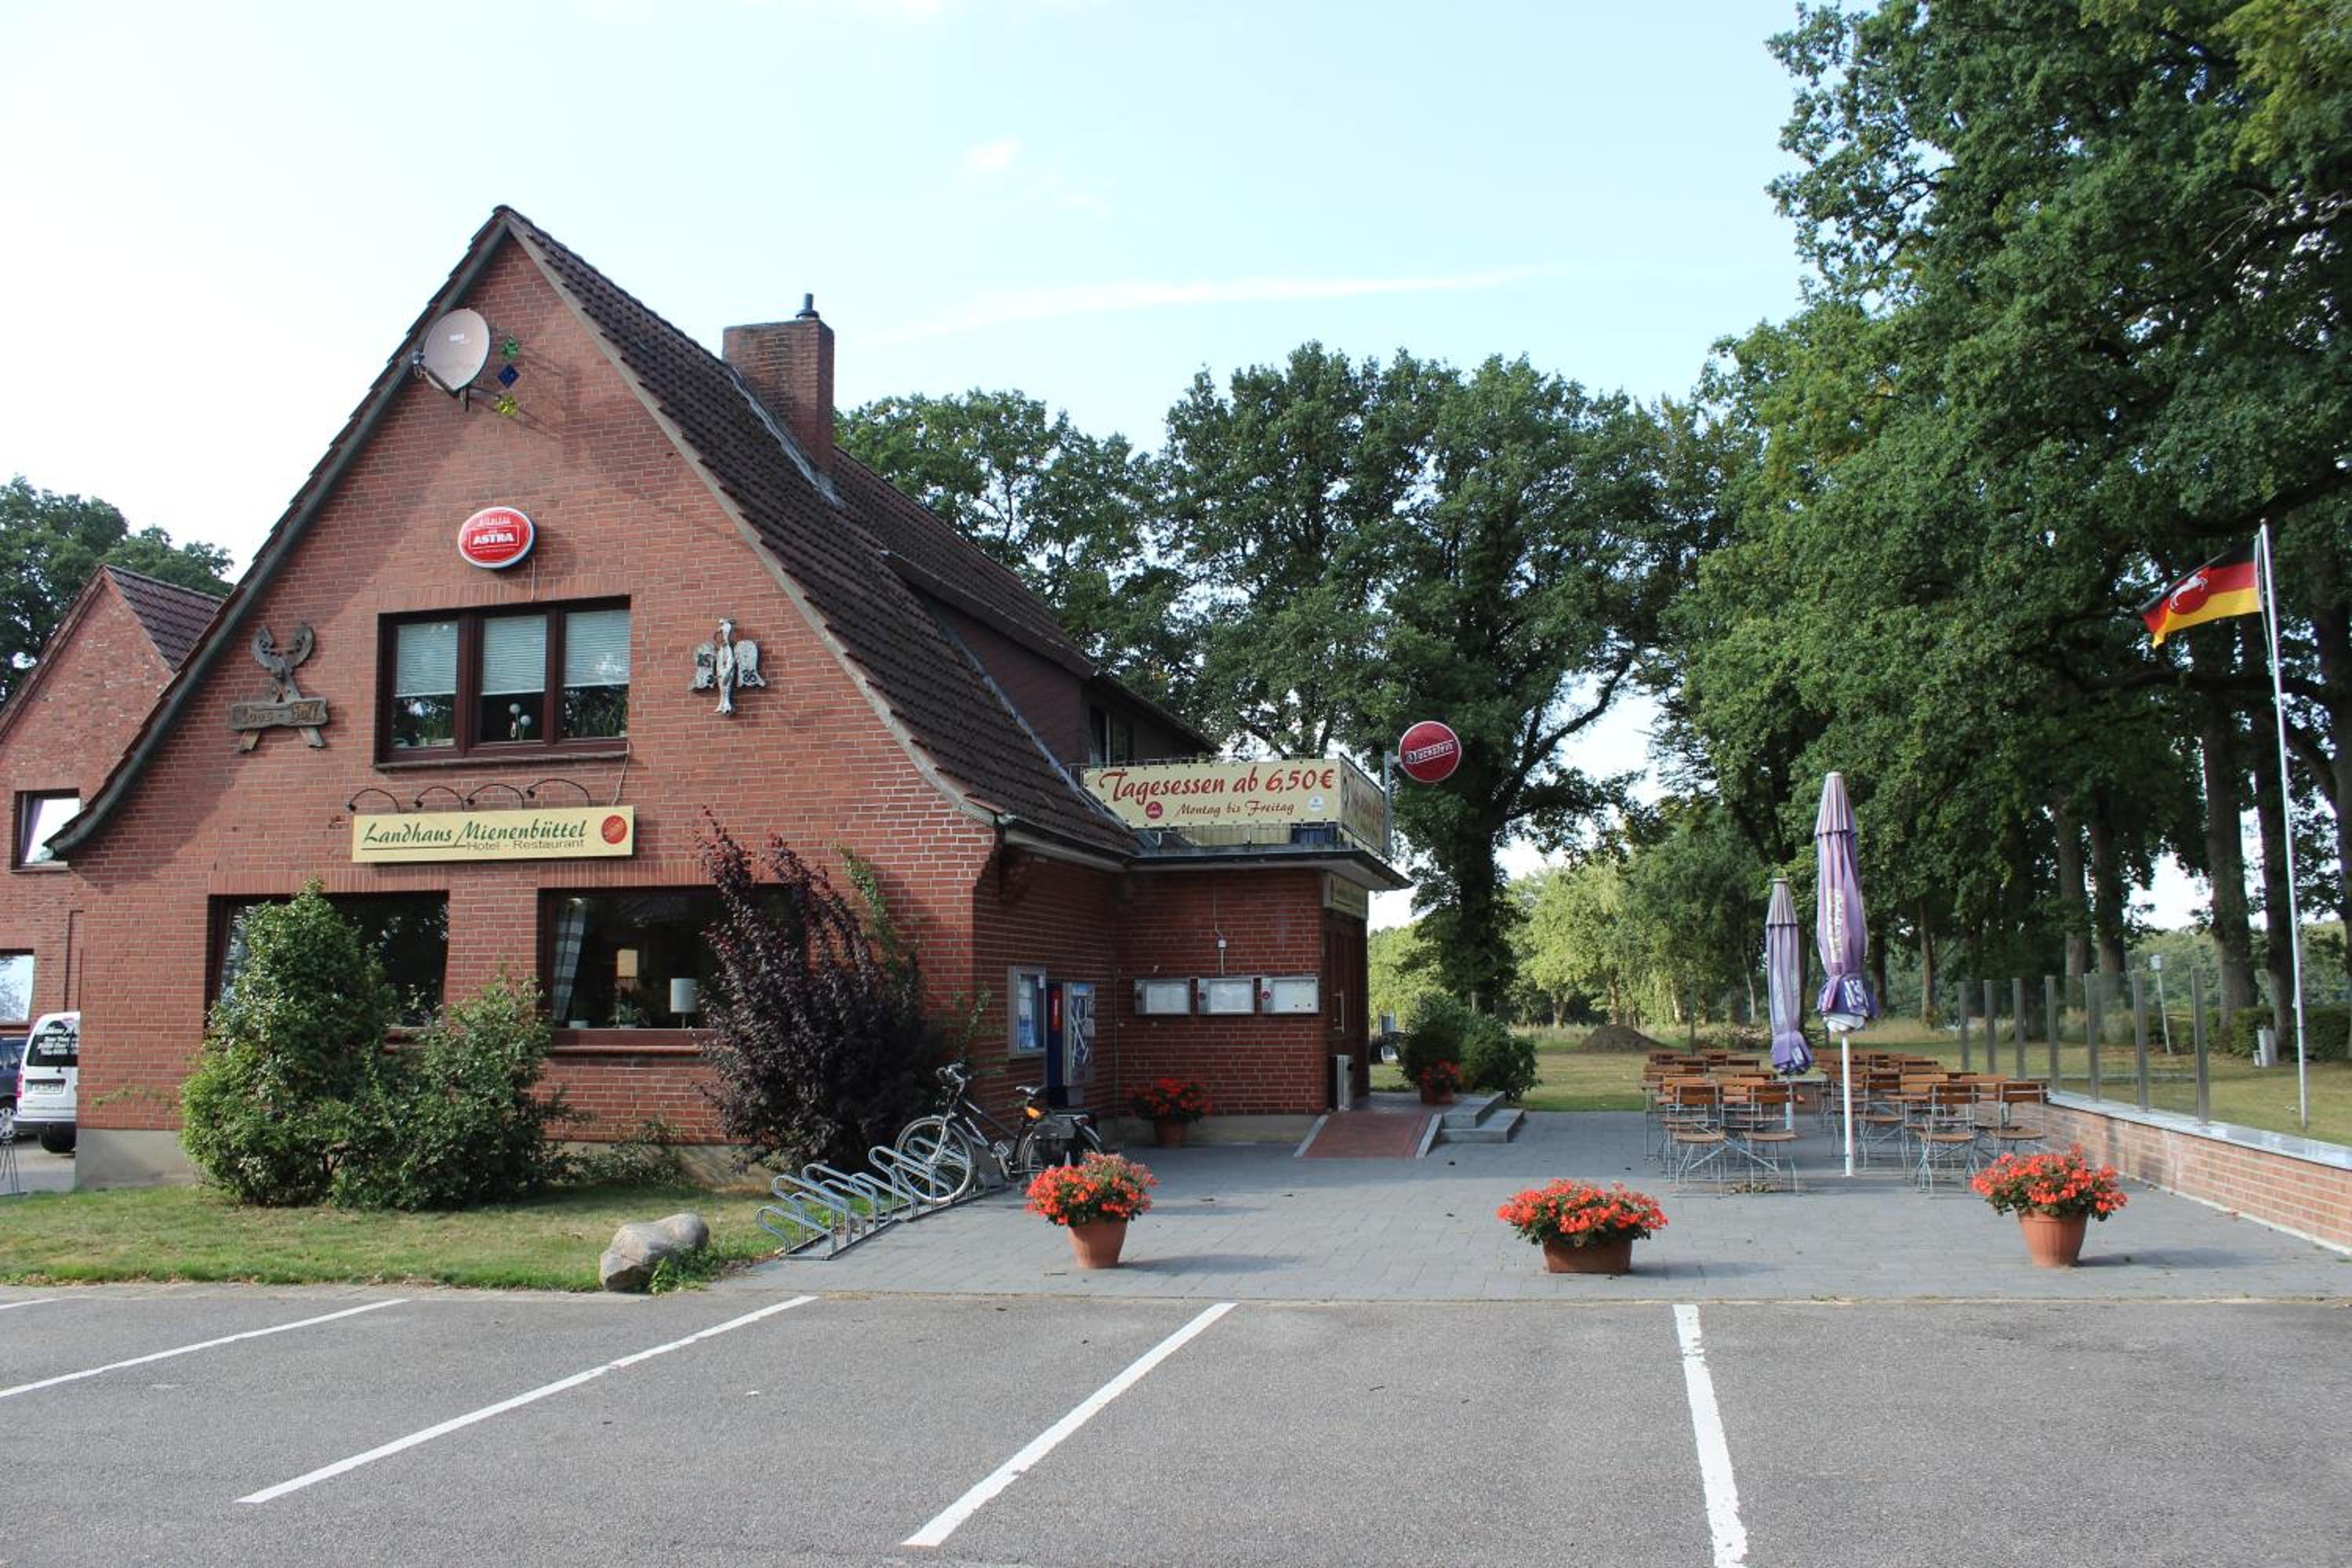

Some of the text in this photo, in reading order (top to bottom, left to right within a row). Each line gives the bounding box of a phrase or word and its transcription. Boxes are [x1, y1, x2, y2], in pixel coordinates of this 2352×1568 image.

[472, 533, 514, 545] ASTRA
[1098, 770, 1225, 805] Tagesessen
[1232, 766, 1258, 793] ab
[1175, 800, 1294, 817] Montag bis Freitag
[363, 818, 587, 847] Landhaus Mienenbüttel
[466, 840, 499, 851] Hotel
[514, 839, 584, 850] Restaurant
